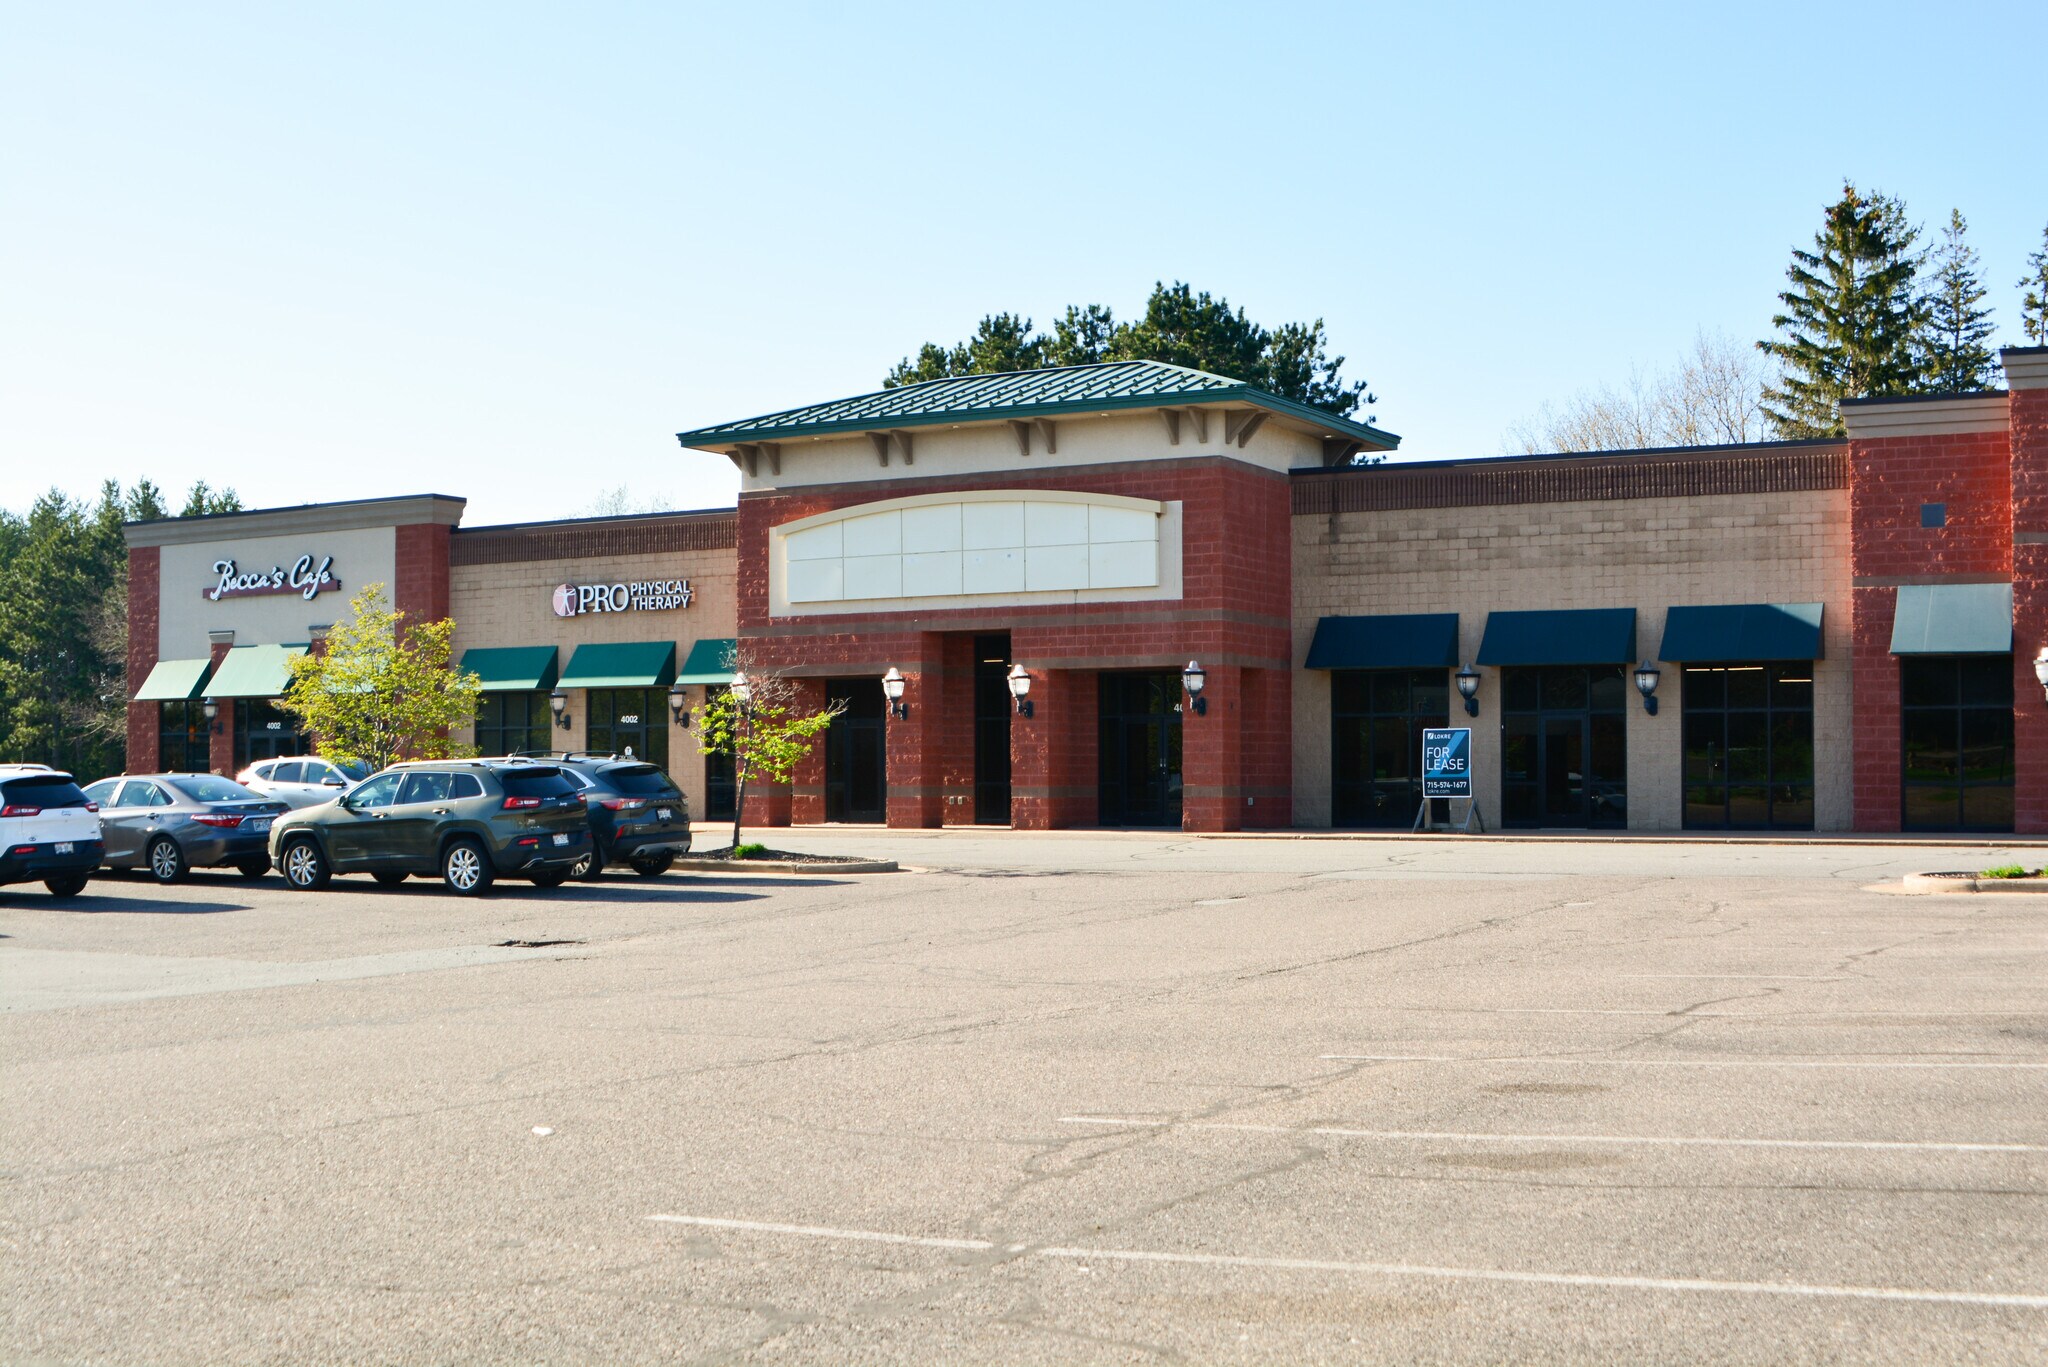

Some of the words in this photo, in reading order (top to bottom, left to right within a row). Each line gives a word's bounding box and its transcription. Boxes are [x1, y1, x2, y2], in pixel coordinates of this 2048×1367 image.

[210, 560, 283, 600] Becca's
[290, 554, 332, 600] Cafe
[630, 580, 690, 596] PHYSICAL
[577, 583, 630, 613] PRO
[632, 595, 689, 611] THERAPY
[621, 715, 638, 724] 4002
[1426, 747, 1450, 758] FOR
[1426, 759, 1464, 770] LEASE
[1427, 781, 1467, 789] 715-574-1677
